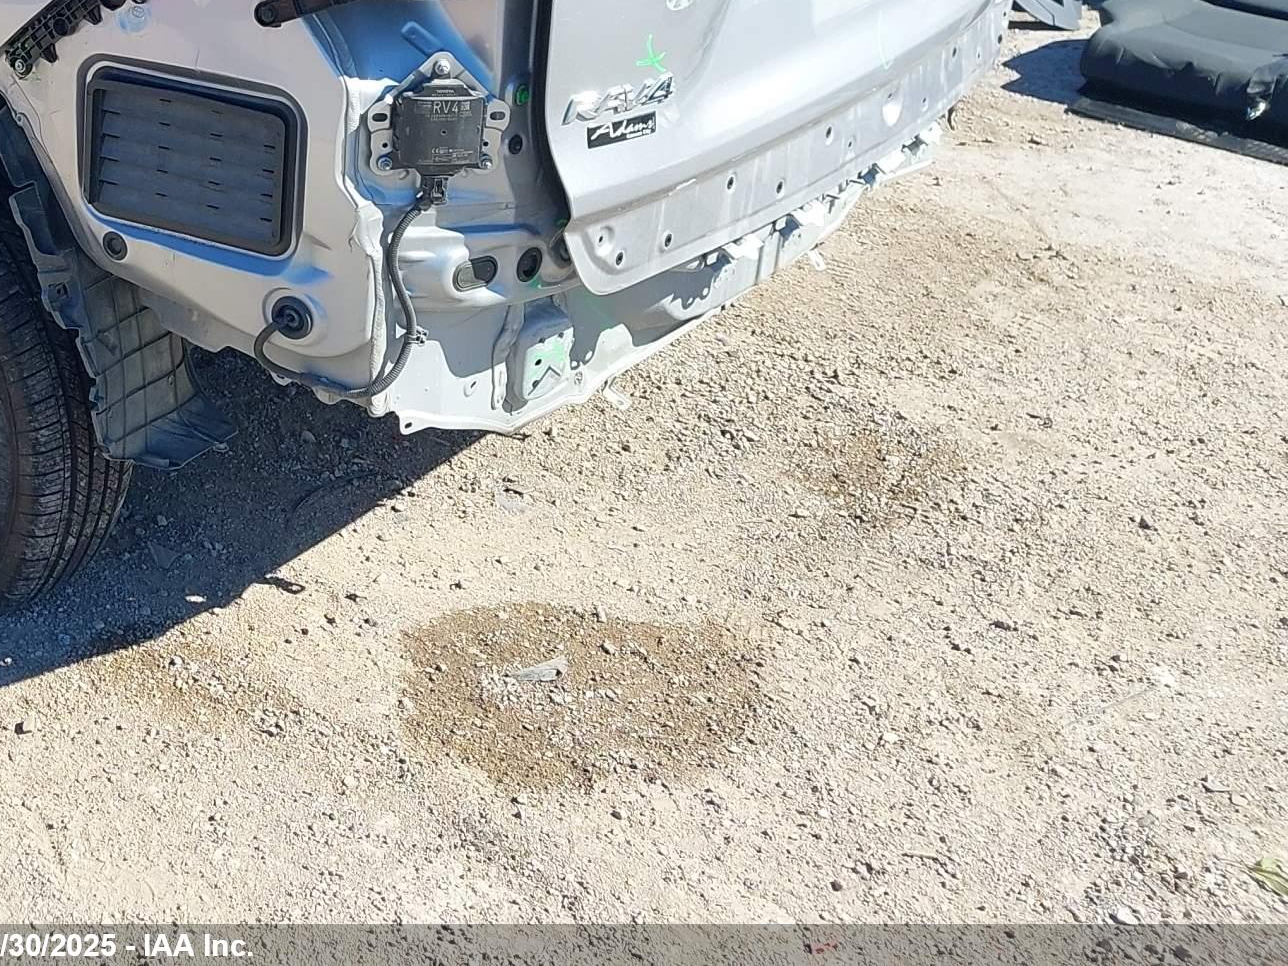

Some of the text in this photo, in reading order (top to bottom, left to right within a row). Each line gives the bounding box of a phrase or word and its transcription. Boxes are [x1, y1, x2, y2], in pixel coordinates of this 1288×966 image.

[432, 100, 459, 114] RV4
[560, 72, 675, 126] RAV4
[590, 119, 656, 141] Adams
